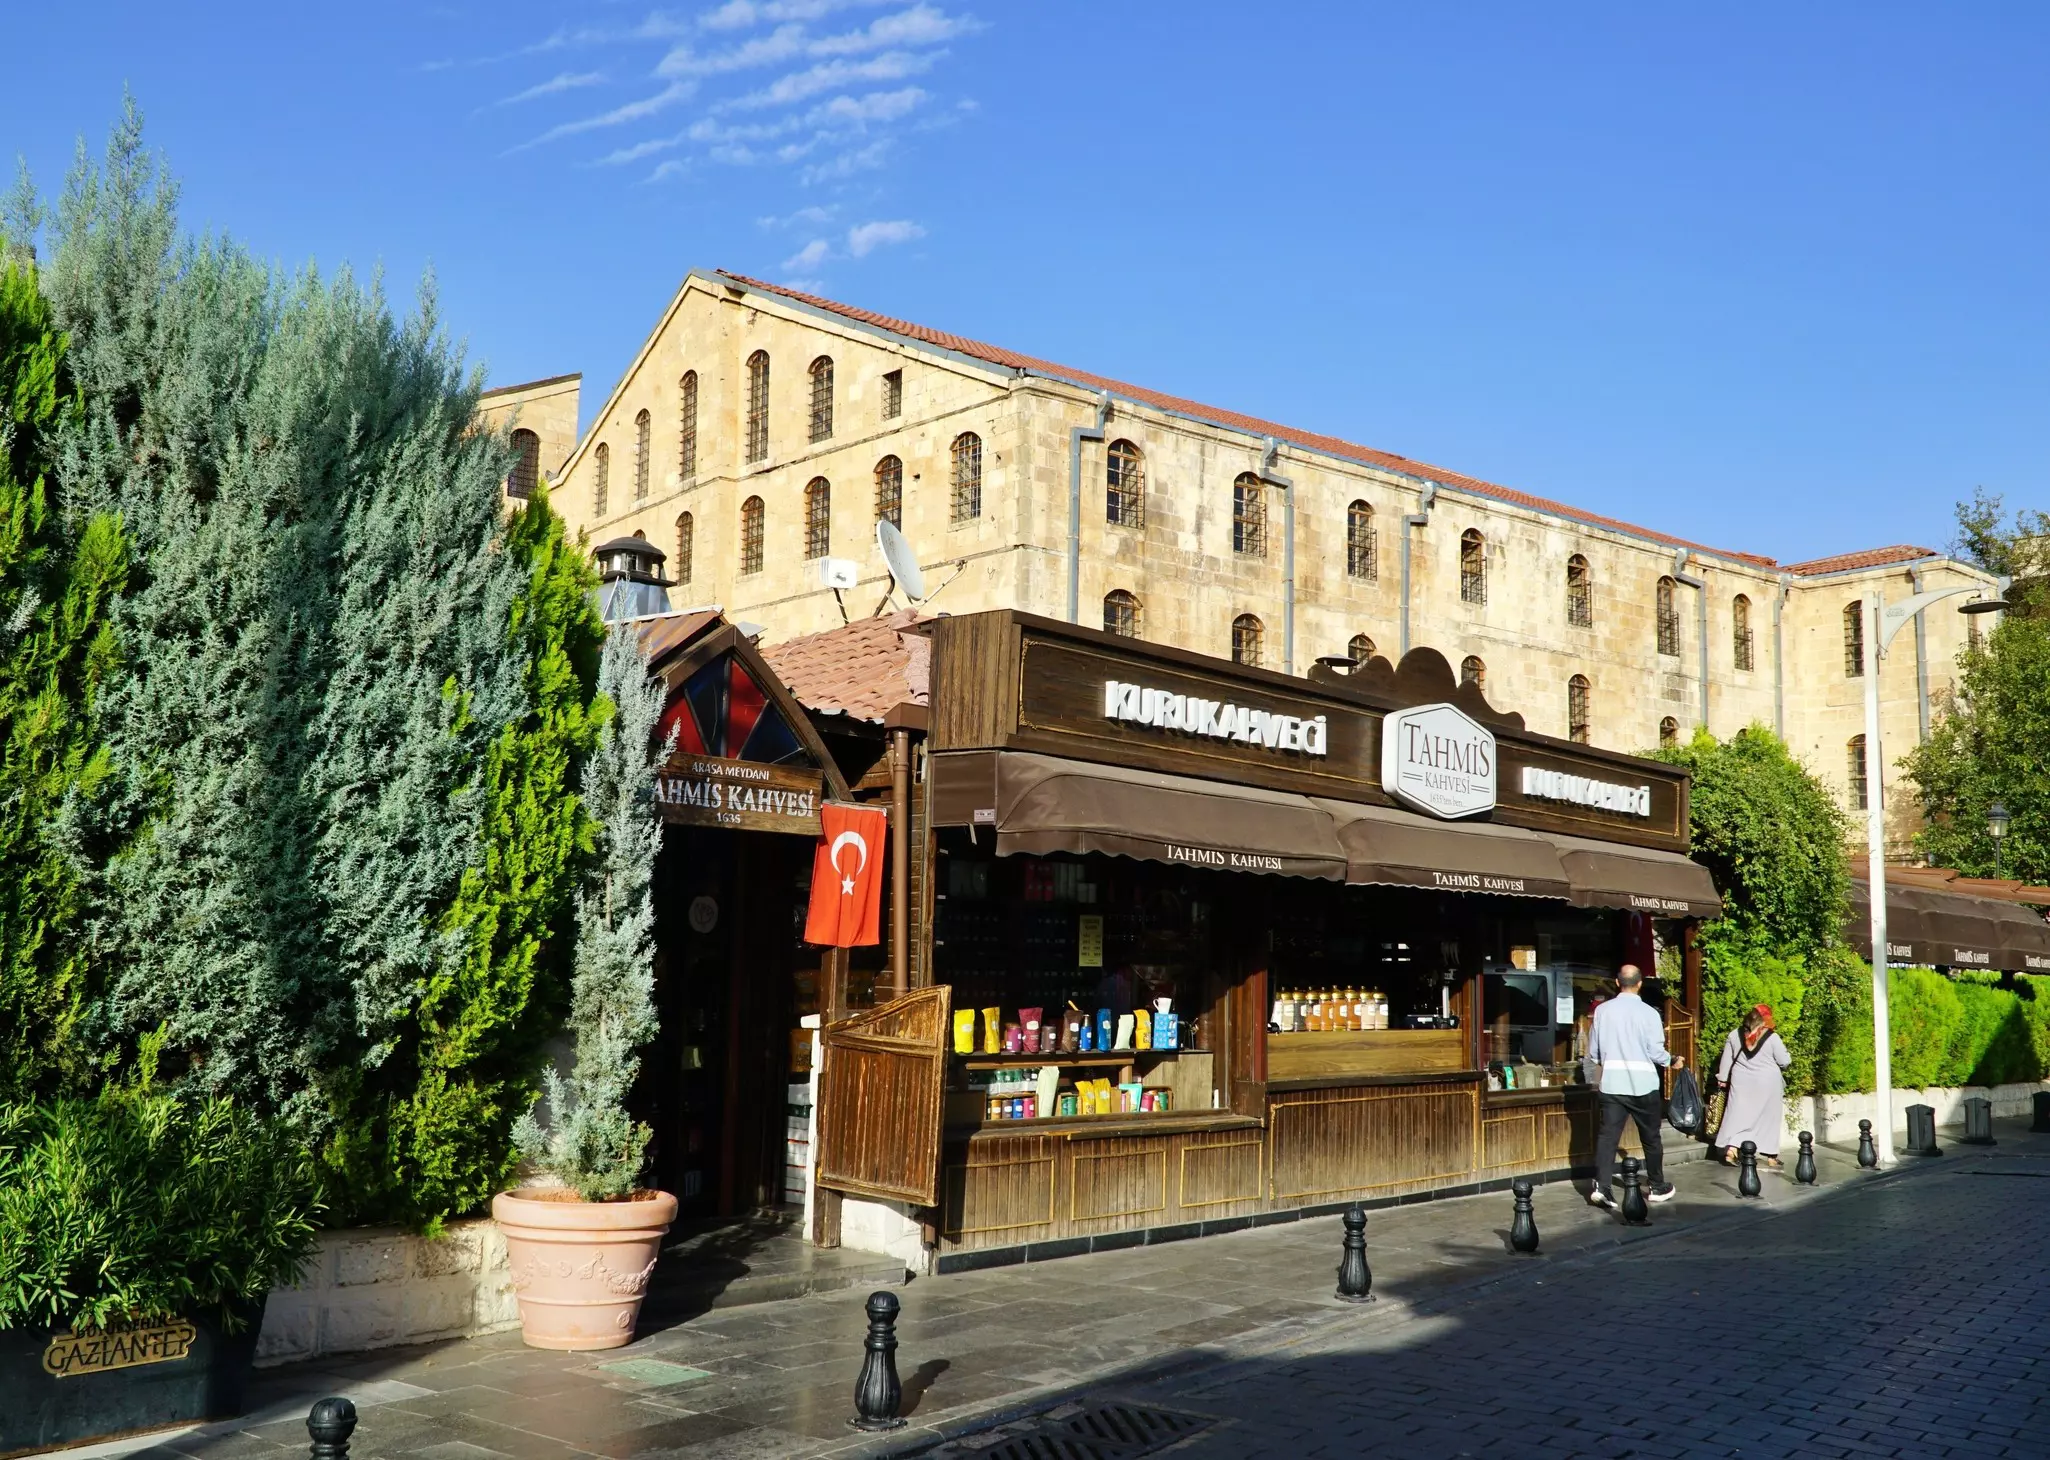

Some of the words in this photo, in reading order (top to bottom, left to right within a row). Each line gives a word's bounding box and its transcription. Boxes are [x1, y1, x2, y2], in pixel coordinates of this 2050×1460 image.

[1105, 680, 1327, 756] KURUKAHVECİ
[1403, 722, 1490, 778] TAHMİS
[691, 761, 723, 776] ARASA
[725, 766, 770, 781] MEYDANI
[1424, 772, 1471, 795] KAHVESİ
[651, 777, 722, 809] AHMİS
[727, 784, 815, 818] KAHVESİ
[716, 812, 741, 824] 1635
[1432, 872, 1480, 888] TAHMİS
[1483, 877, 1525, 892] KAHVESİ
[47, 1328, 193, 1373] GAZİANTEP
